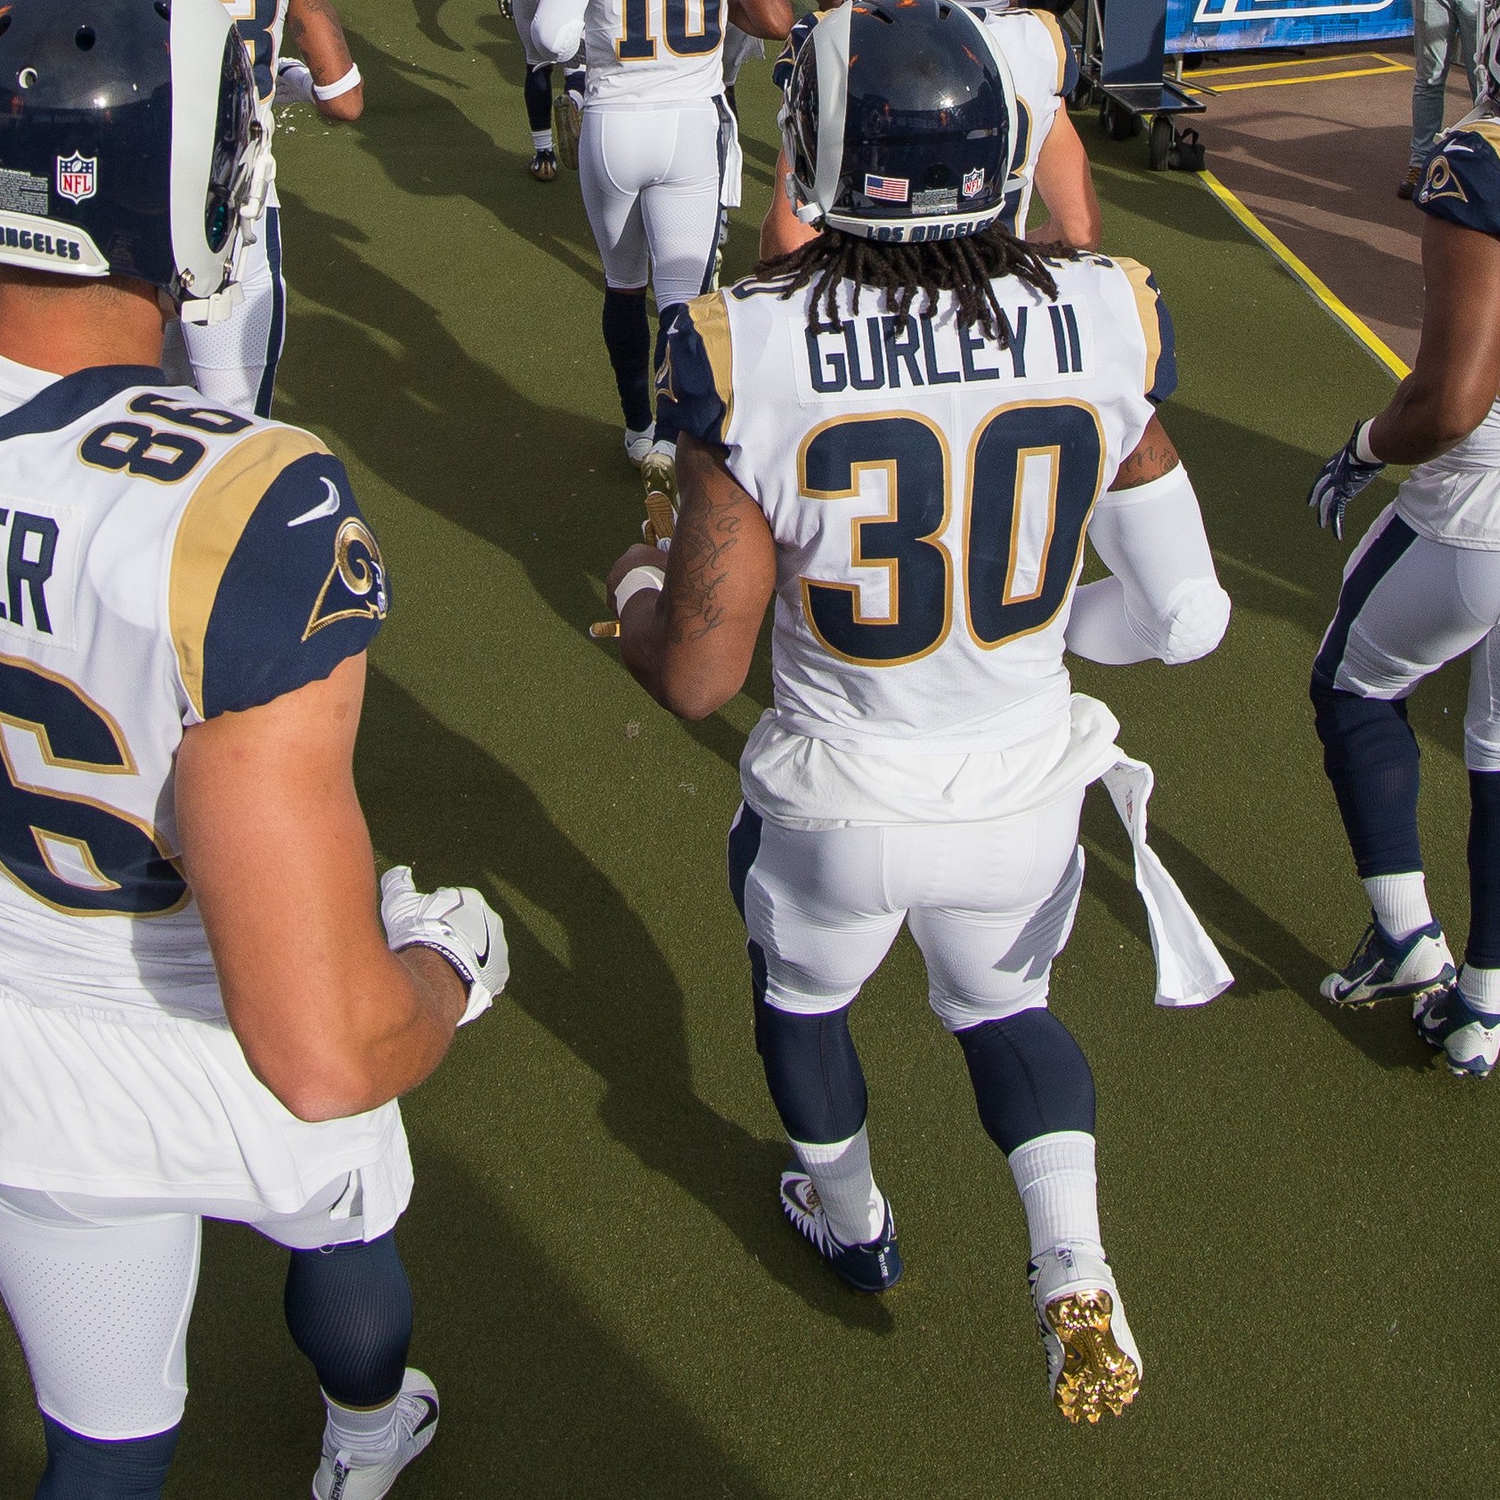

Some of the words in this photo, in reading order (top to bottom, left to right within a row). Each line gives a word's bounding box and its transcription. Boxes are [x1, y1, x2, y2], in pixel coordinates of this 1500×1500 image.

[62, 173, 92, 194] NFL
[965, 179, 983, 195] NFL
[866, 223, 904, 242] LOS
[909, 216, 994, 241] ANGELES
[804, 305, 1029, 394] GURLEY
[1049, 303, 1084, 374] II
[77, 392, 255, 486] 86
[796, 397, 1107, 668] 30
